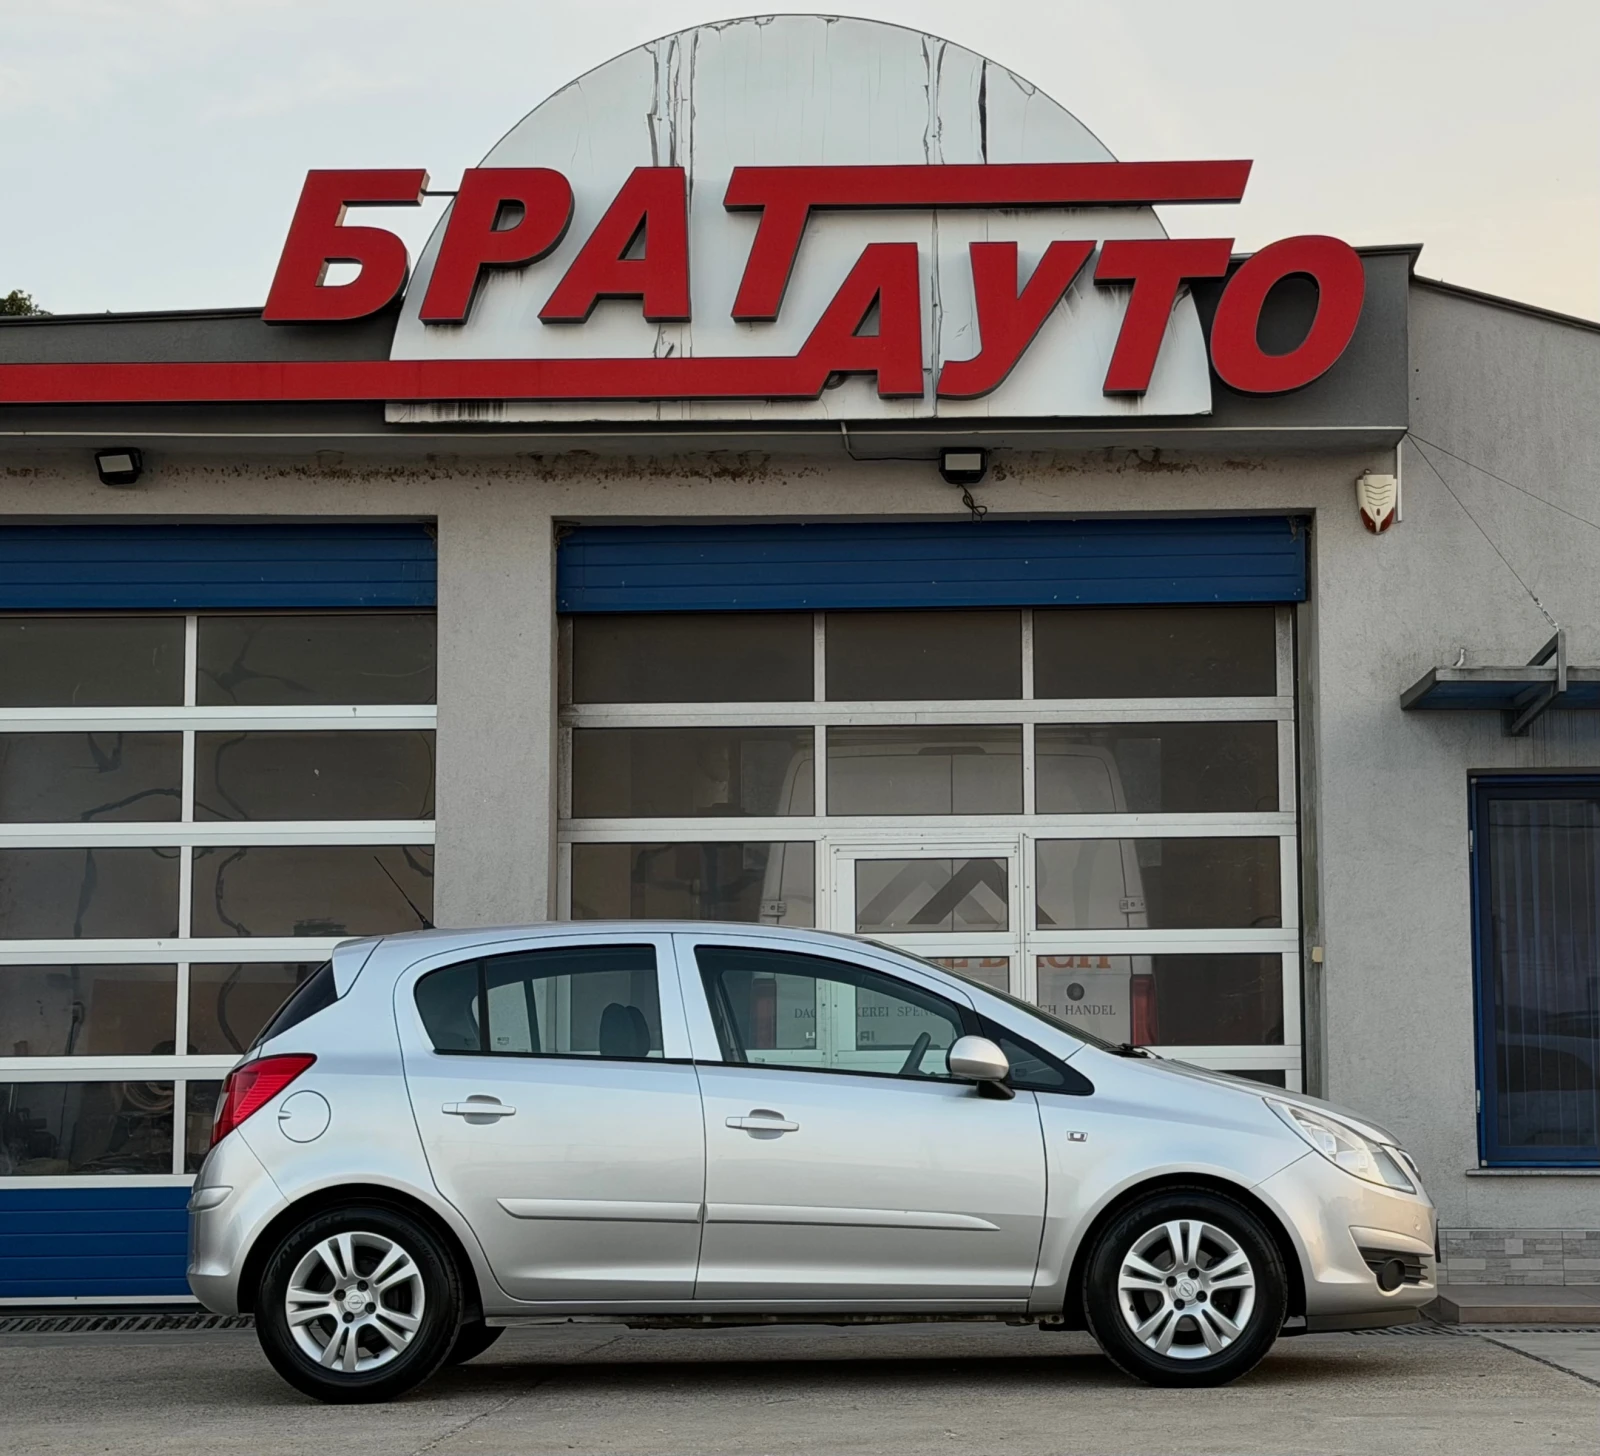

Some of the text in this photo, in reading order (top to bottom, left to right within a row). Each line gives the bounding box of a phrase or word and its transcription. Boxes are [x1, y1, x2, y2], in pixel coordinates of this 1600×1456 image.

[263, 160, 1252, 326] БРАТ
[797, 235, 1366, 398] АУТО
[1065, 1004, 1116, 1016] HANDEL
